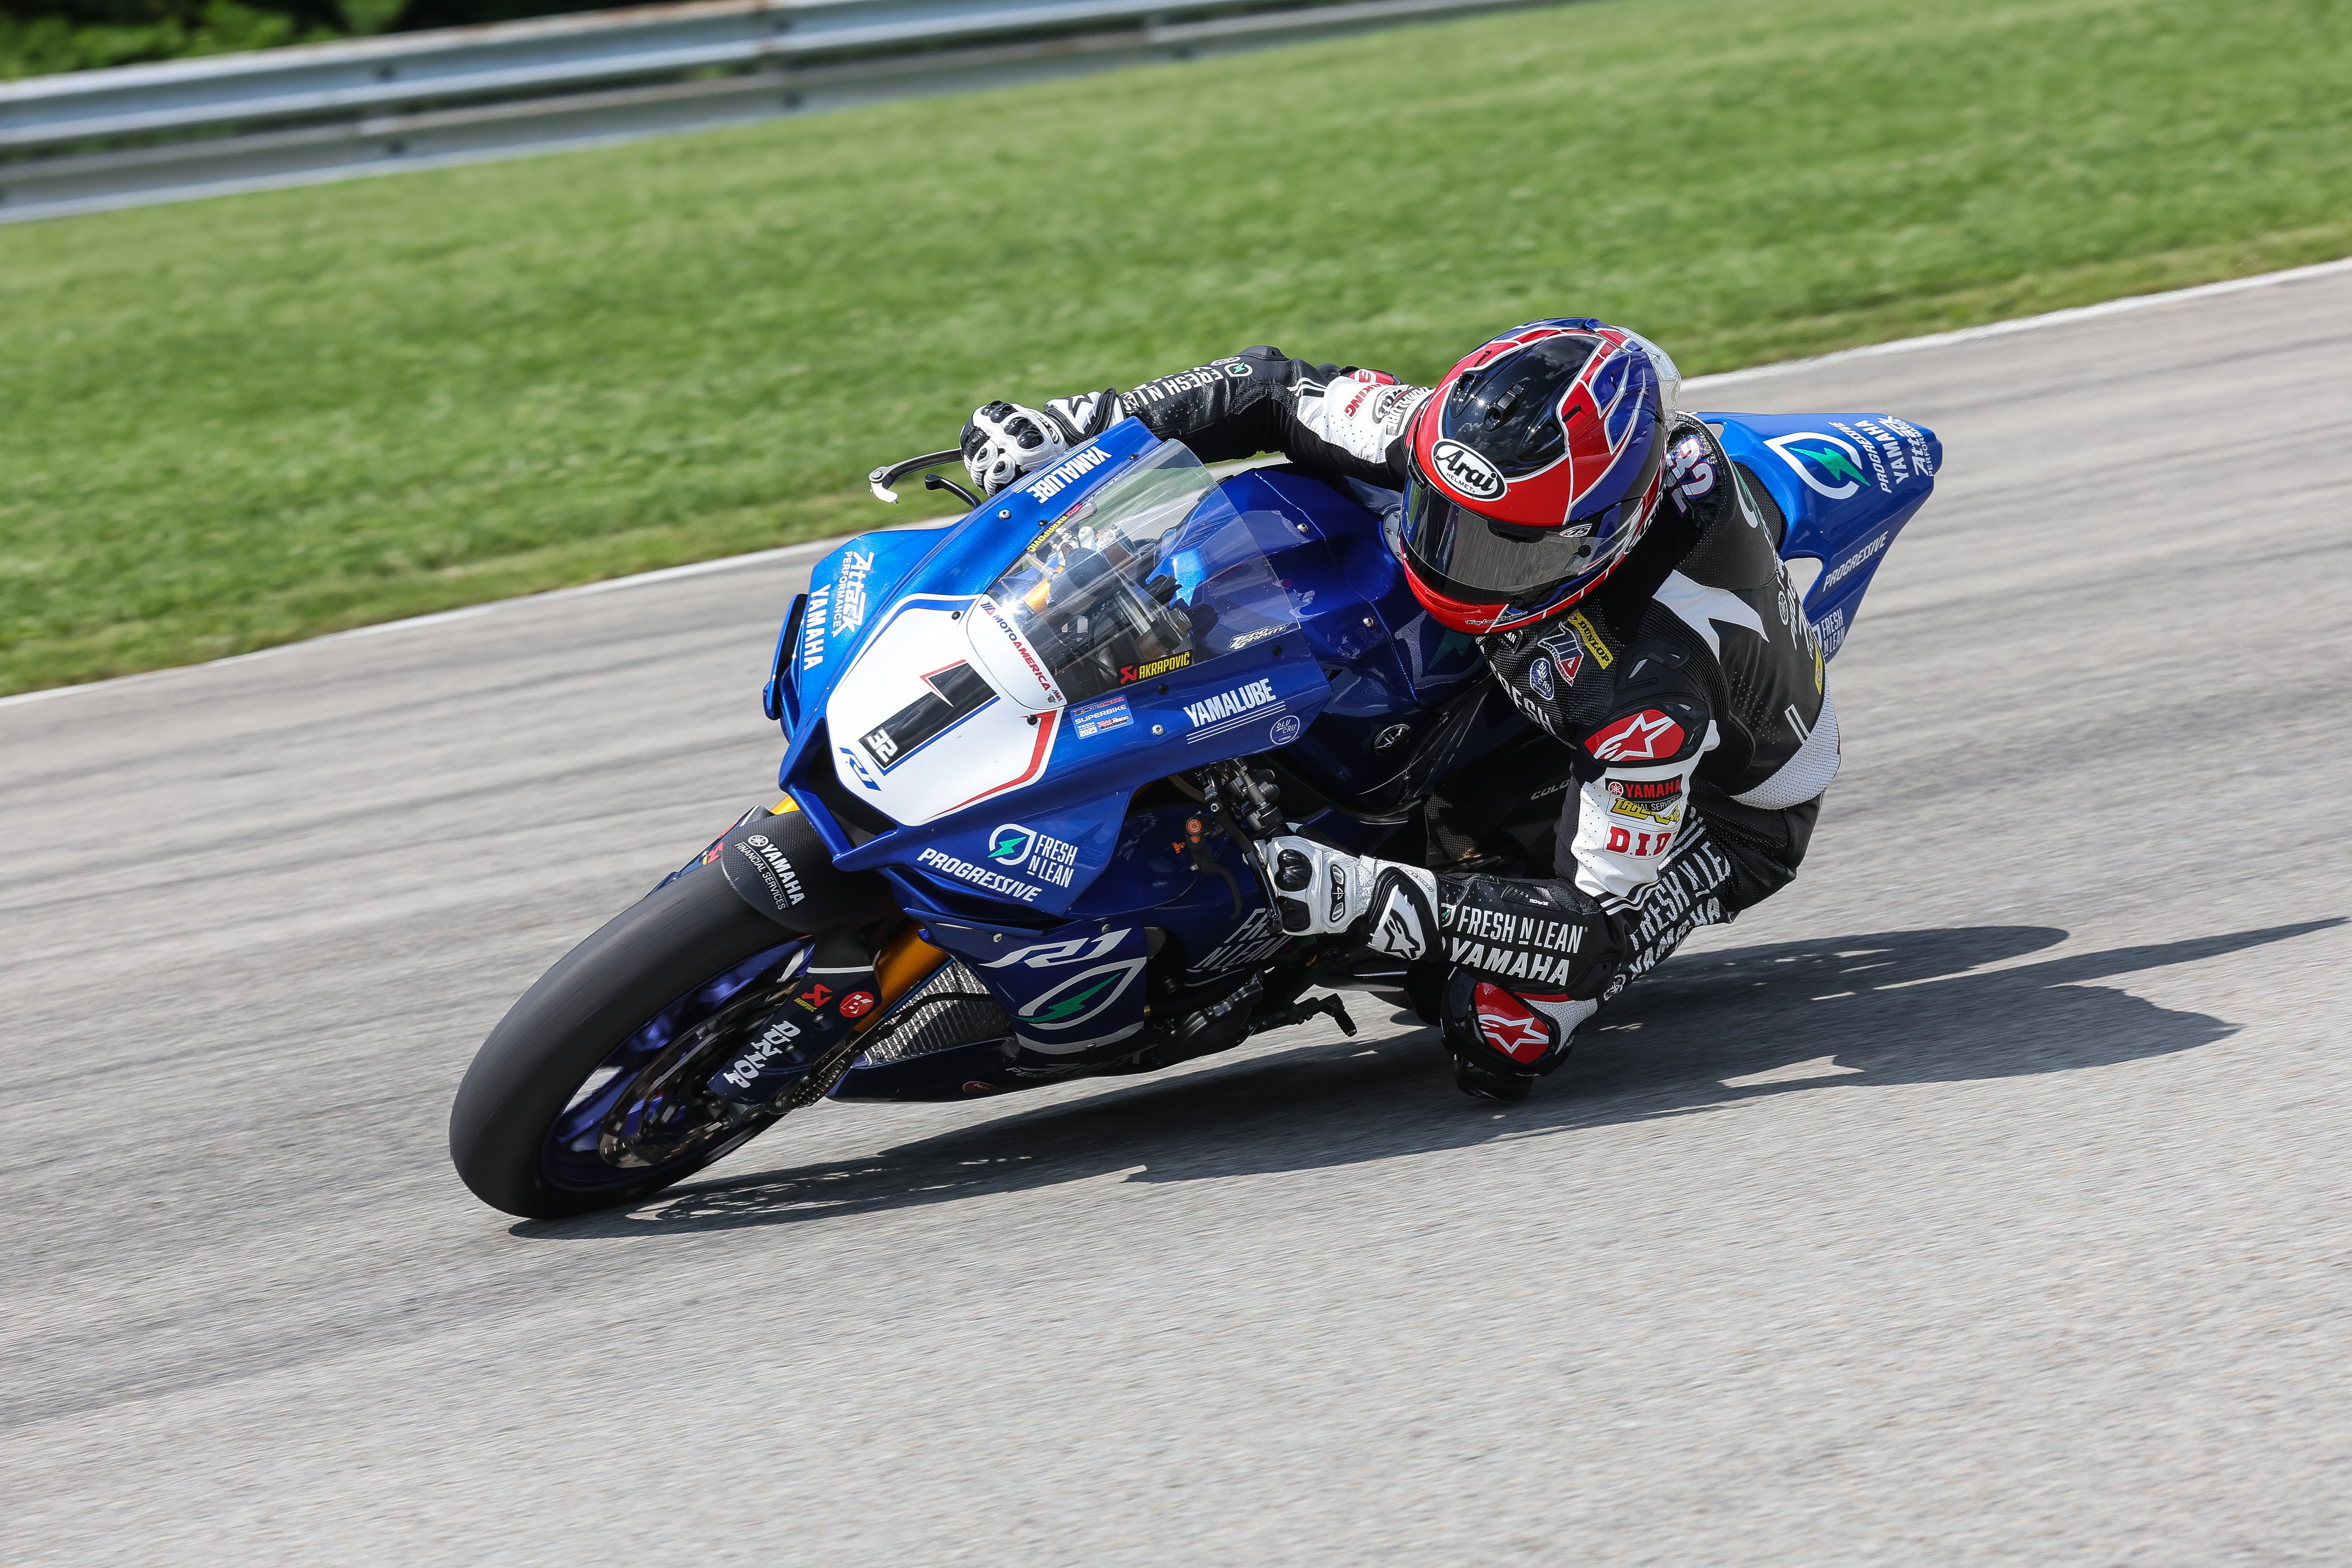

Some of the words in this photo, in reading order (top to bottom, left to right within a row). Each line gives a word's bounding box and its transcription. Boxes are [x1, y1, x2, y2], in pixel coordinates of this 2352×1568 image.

[1145, 385, 1165, 401] N
[1162, 369, 1224, 396] FRESH
[1435, 450, 1497, 492] Arai
[1828, 421, 1892, 494] PROGRESSIVE
[1854, 419, 1909, 484] YAMAHA
[1026, 445, 1112, 504] YAMALUBE
[1823, 530, 1889, 592] PROGRESSIVE
[831, 551, 874, 638] Attack
[833, 551, 852, 628] PERFORMANCE
[804, 584, 831, 671] YAMAHA
[1230, 628, 1269, 648] ZERO
[1234, 626, 1286, 650] GRAVITY
[1578, 620, 1609, 662] DUNLOP
[1821, 608, 1843, 638] FRESH
[1830, 626, 1845, 653] LEAN
[993, 615, 1051, 691] MOTOAMERICA
[858, 661, 998, 770] 1
[1075, 704, 1127, 724] SUPERBIKE
[1184, 678, 1277, 728] YAMALUBE
[866, 727, 899, 767] 32
[1079, 726, 1098, 738] 2023
[1283, 724, 1296, 734] CRU
[1625, 779, 1681, 798] YAMAHA
[1651, 795, 1681, 811] SERVICES
[1027, 858, 1039, 875] N
[1038, 864, 1074, 887] LEAN
[1034, 834, 1078, 866] FRESH
[734, 842, 766, 873] FINANCIAL
[762, 871, 786, 910] SERVICES
[760, 844, 805, 906] YAMAHA
[917, 848, 1043, 902] PROGRESSIVE
[1457, 906, 1517, 943] FRESH
[1519, 917, 1534, 945] N
[1534, 920, 1583, 954] LEAN
[1450, 938, 1570, 986] YAMAHA
[723, 1020, 801, 1089] DUNLOP
